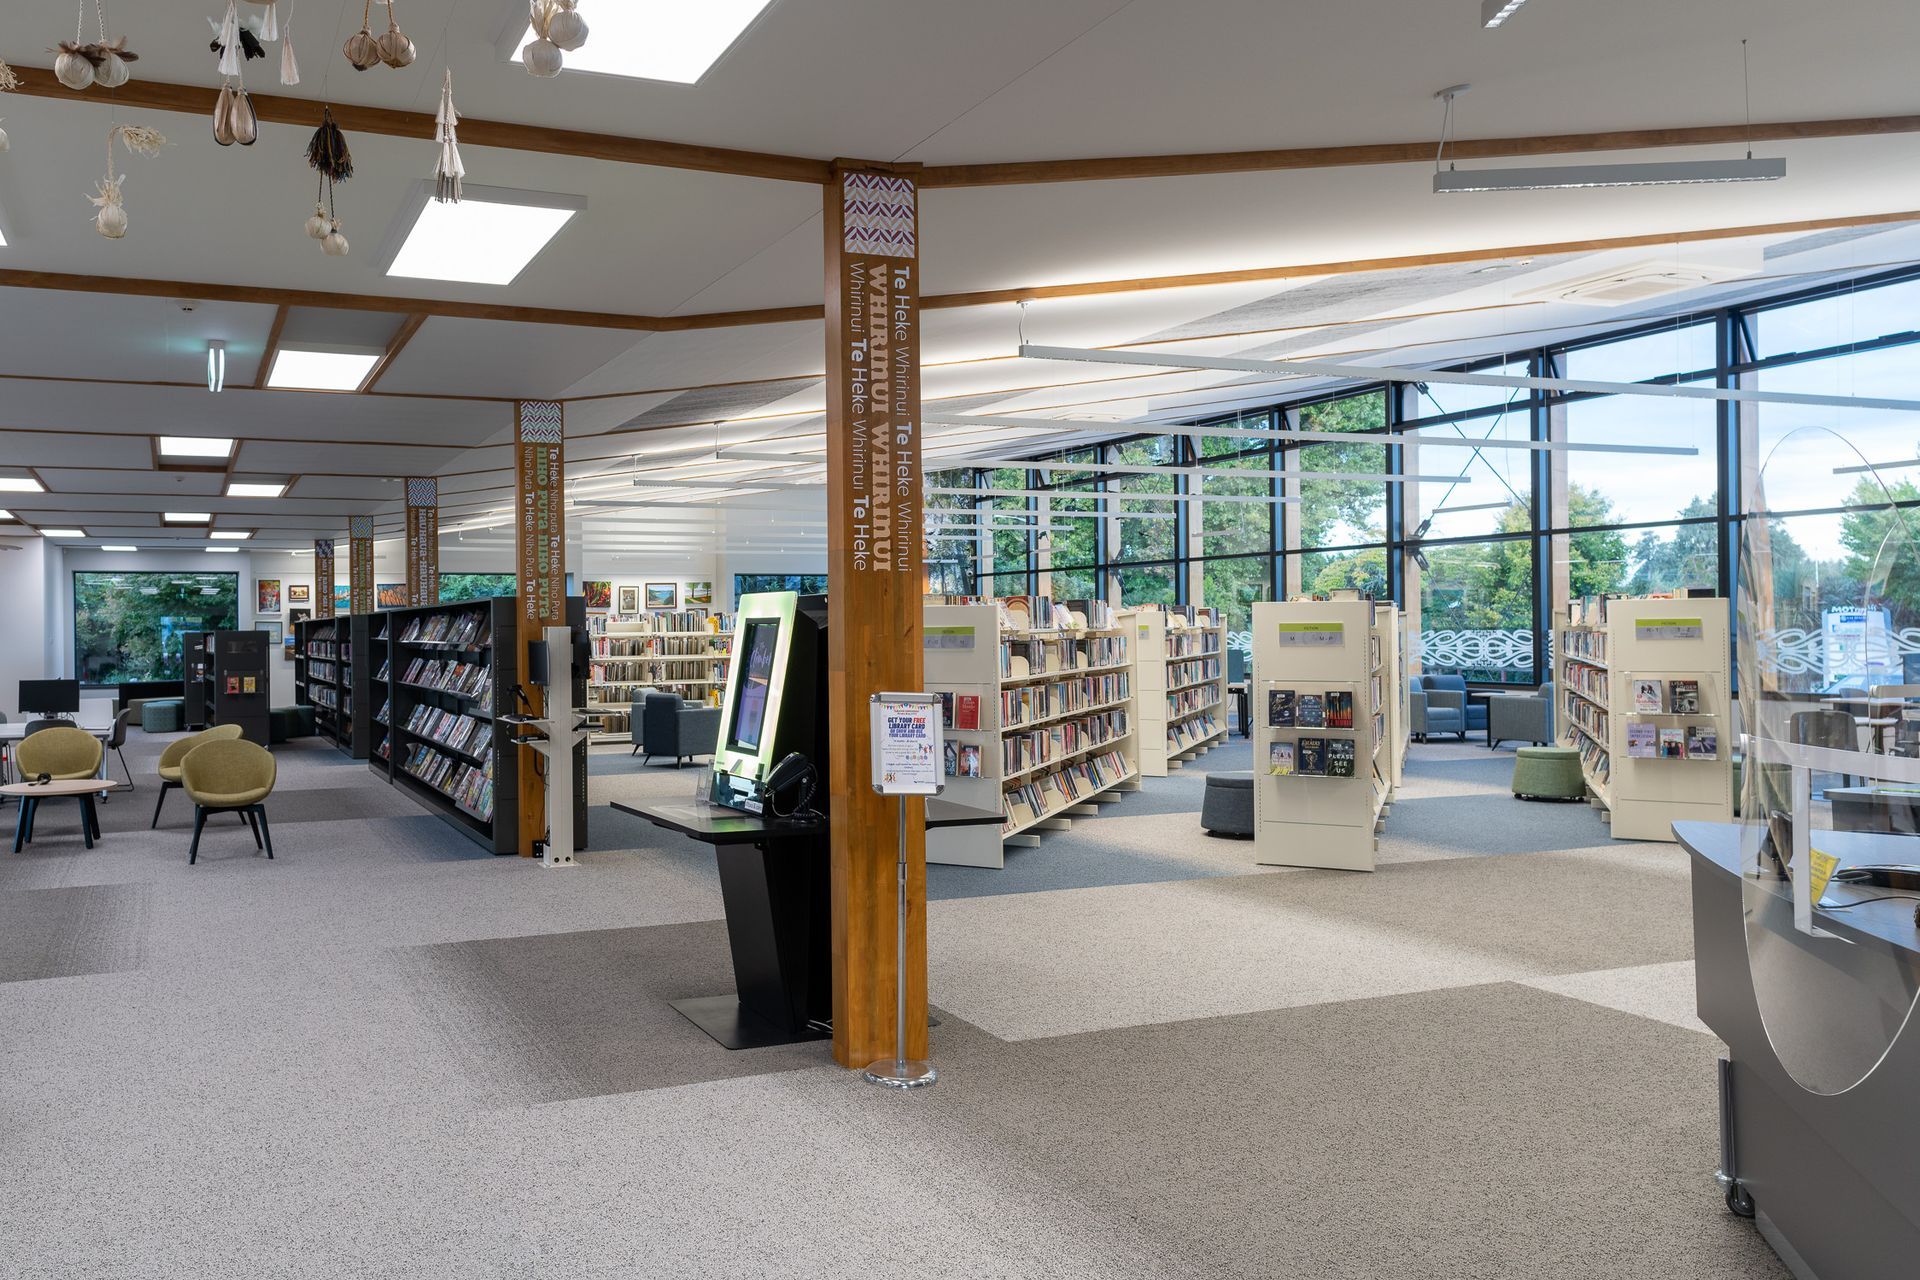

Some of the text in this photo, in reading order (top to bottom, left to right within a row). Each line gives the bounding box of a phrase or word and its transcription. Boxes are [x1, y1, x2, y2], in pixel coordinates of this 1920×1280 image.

[850, 262, 870, 570] Whirinui Te Heke Whirinui Te Heke
[894, 266, 912, 571] Te Heke Whirinui Te Heke Whirinui
[550, 448, 560, 460] Te
[550, 462, 560, 486] Heke
[550, 490, 559, 510] Niho
[428, 509, 434, 518] Te
[411, 537, 418, 546] Te
[524, 446, 536, 620] Niho Puta Te Heke Niho Puta Te Heke
[550, 536, 560, 548] Te
[428, 566, 436, 574] Te
[550, 550, 560, 574] Heke
[552, 578, 560, 598] Niho
[552, 600, 560, 620] Puta
